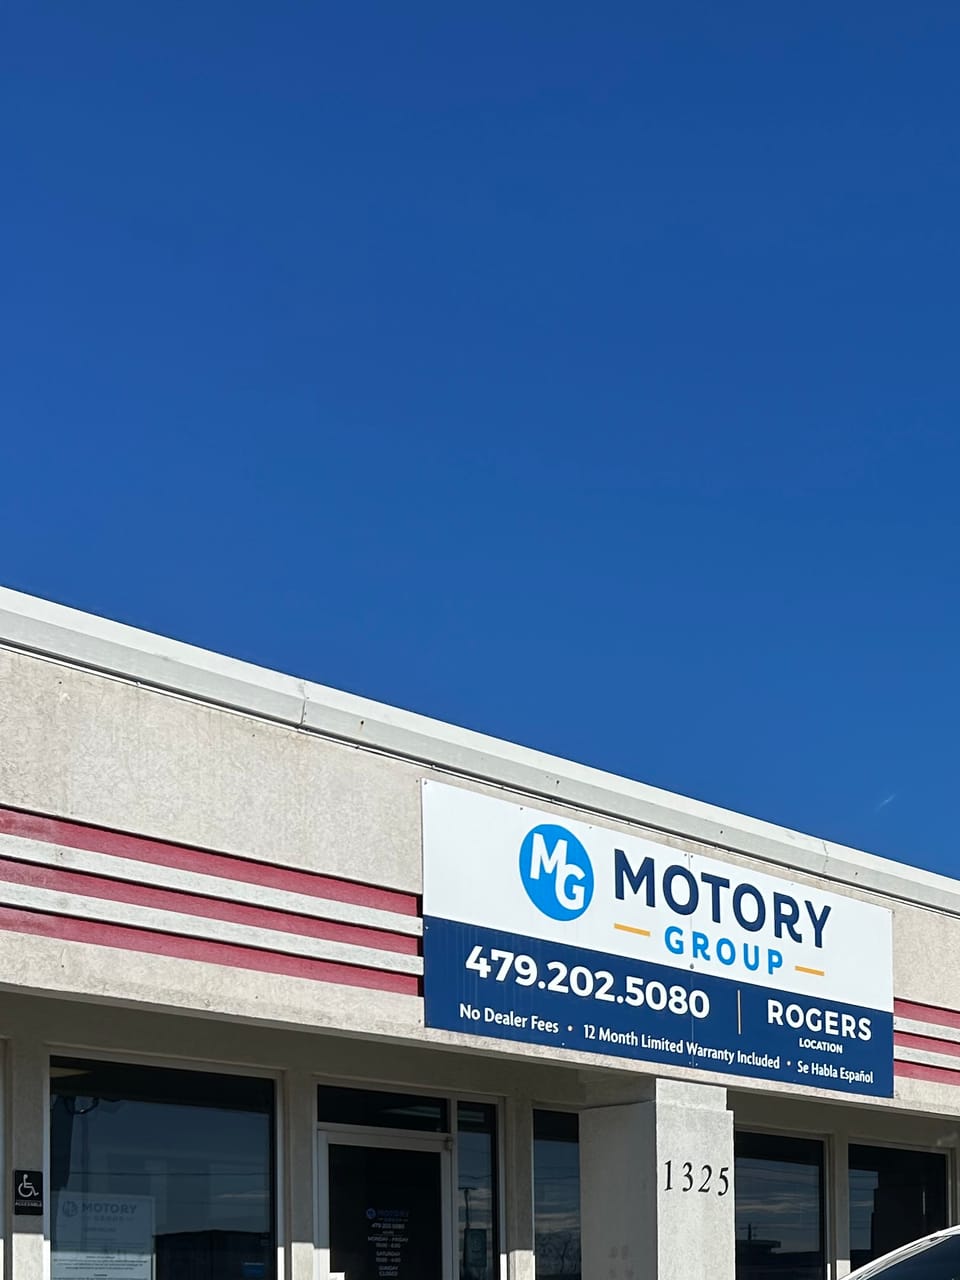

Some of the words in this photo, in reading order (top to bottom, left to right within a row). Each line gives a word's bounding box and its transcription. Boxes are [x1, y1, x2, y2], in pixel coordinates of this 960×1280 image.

[529, 832, 586, 911] MG
[613, 848, 832, 949] MOTORY
[664, 925, 784, 975] GROUP
[465, 945, 710, 1018] 479.202.5080
[459, 1003, 481, 1021] No
[484, 1007, 528, 1029] Dealer
[531, 1015, 560, 1034] Fees
[767, 999, 872, 1041] ROGERS
[583, 1024, 596, 1040] 12
[599, 1026, 639, 1047] Month
[641, 1034, 684, 1054] Limited
[686, 1041, 735, 1065] Warranty
[737, 1050, 780, 1070] Included
[799, 1037, 843, 1054] LOCATION
[797, 1060, 810, 1074] Se
[811, 1063, 838, 1079] Habla
[840, 1067, 874, 1084] Español
[664, 1160, 729, 1197] 1325
